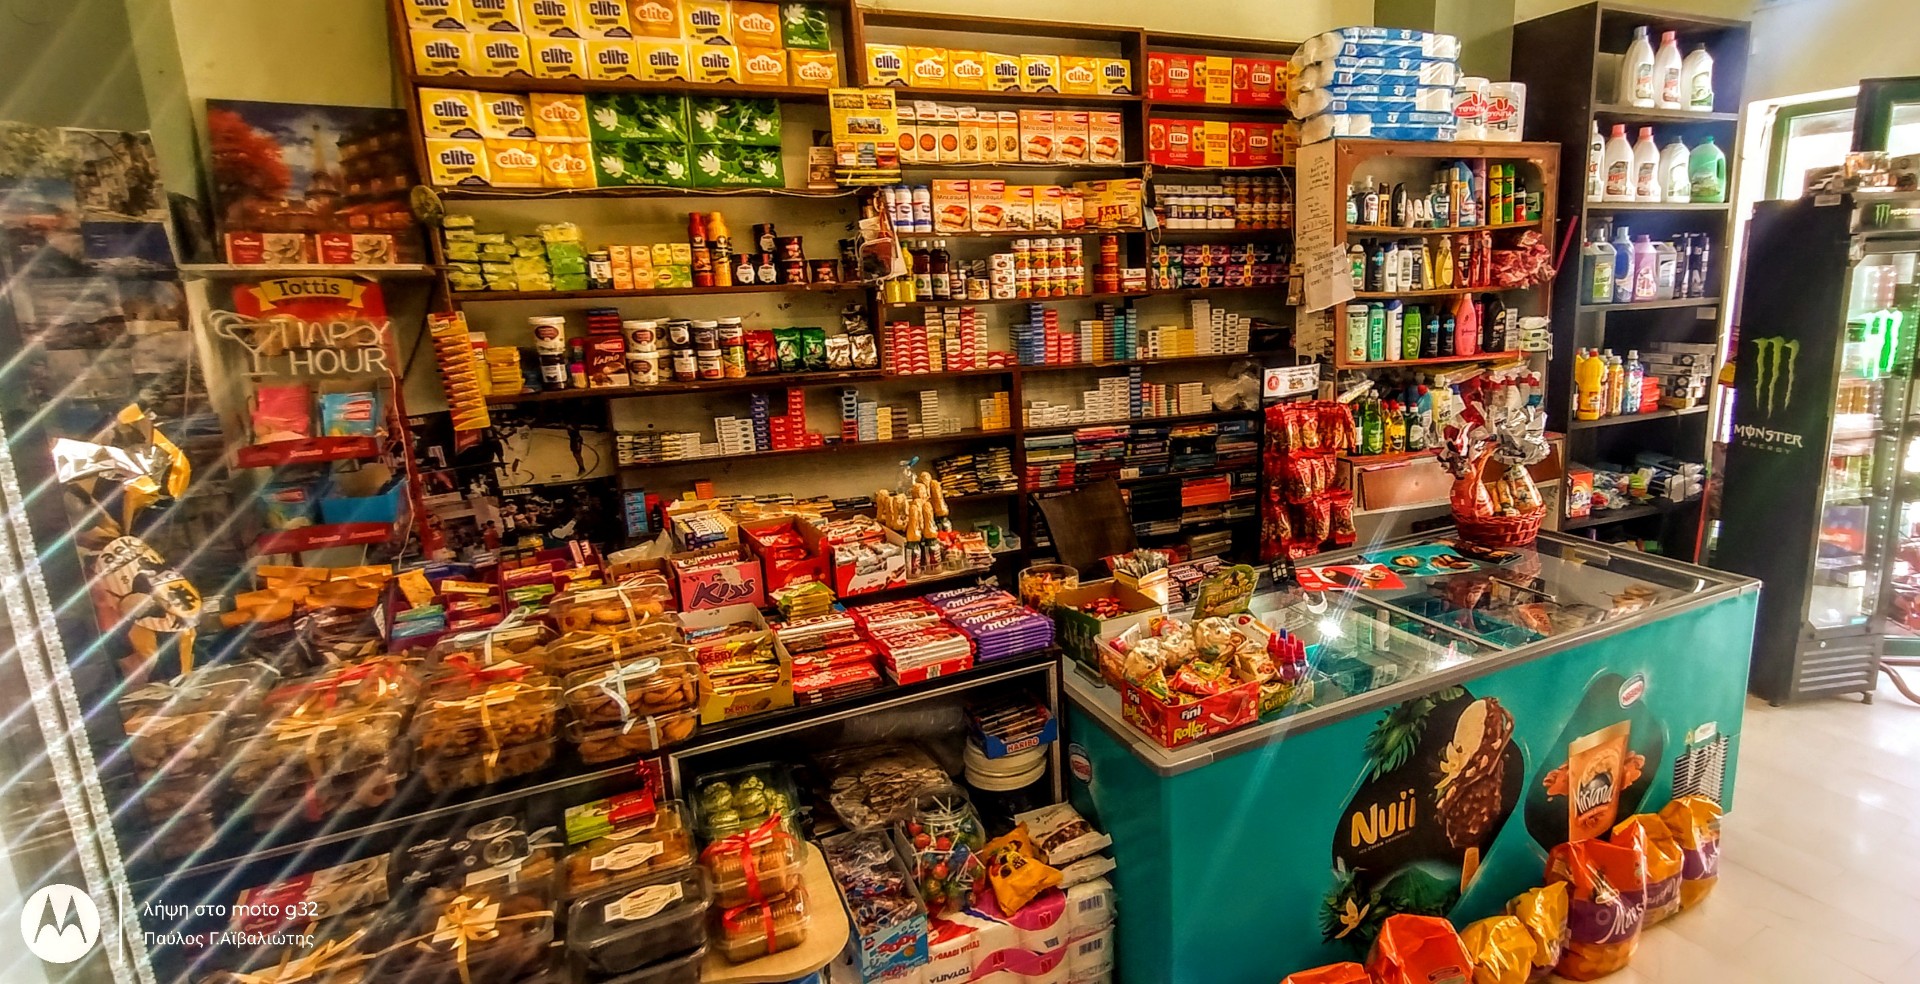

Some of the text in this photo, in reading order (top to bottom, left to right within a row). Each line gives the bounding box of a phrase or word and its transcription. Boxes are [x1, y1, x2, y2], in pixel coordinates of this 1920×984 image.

[534, 1, 566, 17] elite
[589, 1, 620, 17] elite
[638, 7, 671, 21] elite
[691, 9, 721, 26] elite
[742, 18, 772, 31] elite
[425, 42, 460, 59] elite
[486, 42, 520, 59] elite
[541, 48, 573, 64] elite
[599, 49, 629, 65] elite
[650, 52, 679, 67] elite
[750, 59, 780, 72] elite
[874, 55, 901, 69] elite
[917, 64, 942, 76] elite
[956, 64, 981, 76] elite
[995, 63, 1018, 77] elite
[1068, 70, 1091, 81] elite
[1105, 64, 1126, 78] elite
[433, 101, 468, 118] elite
[493, 100, 525, 116] elite
[544, 109, 577, 120] elite
[440, 150, 475, 166] elite
[500, 154, 533, 166] elite
[273, 278, 341, 297] Tottis
[289, 347, 388, 375] HOUR
[1733, 423, 1804, 449] MONSTER
[1741, 440, 1791, 455] ENERGY
[697, 550, 740, 562] PROTEIN
[937, 586, 977, 599] Milka
[946, 593, 988, 609] Milka
[781, 612, 846, 629] Lacta
[965, 609, 1009, 625] Milka
[981, 615, 1031, 631] Milka
[702, 649, 732, 663] DERBY
[1126, 689, 1141, 704] Fini
[724, 703, 750, 714] DERBY
[1181, 704, 1203, 720] Fini
[1172, 722, 1208, 744] Roller
[1007, 736, 1040, 754] HARIBO
[1351, 788, 1416, 848] Nuii
